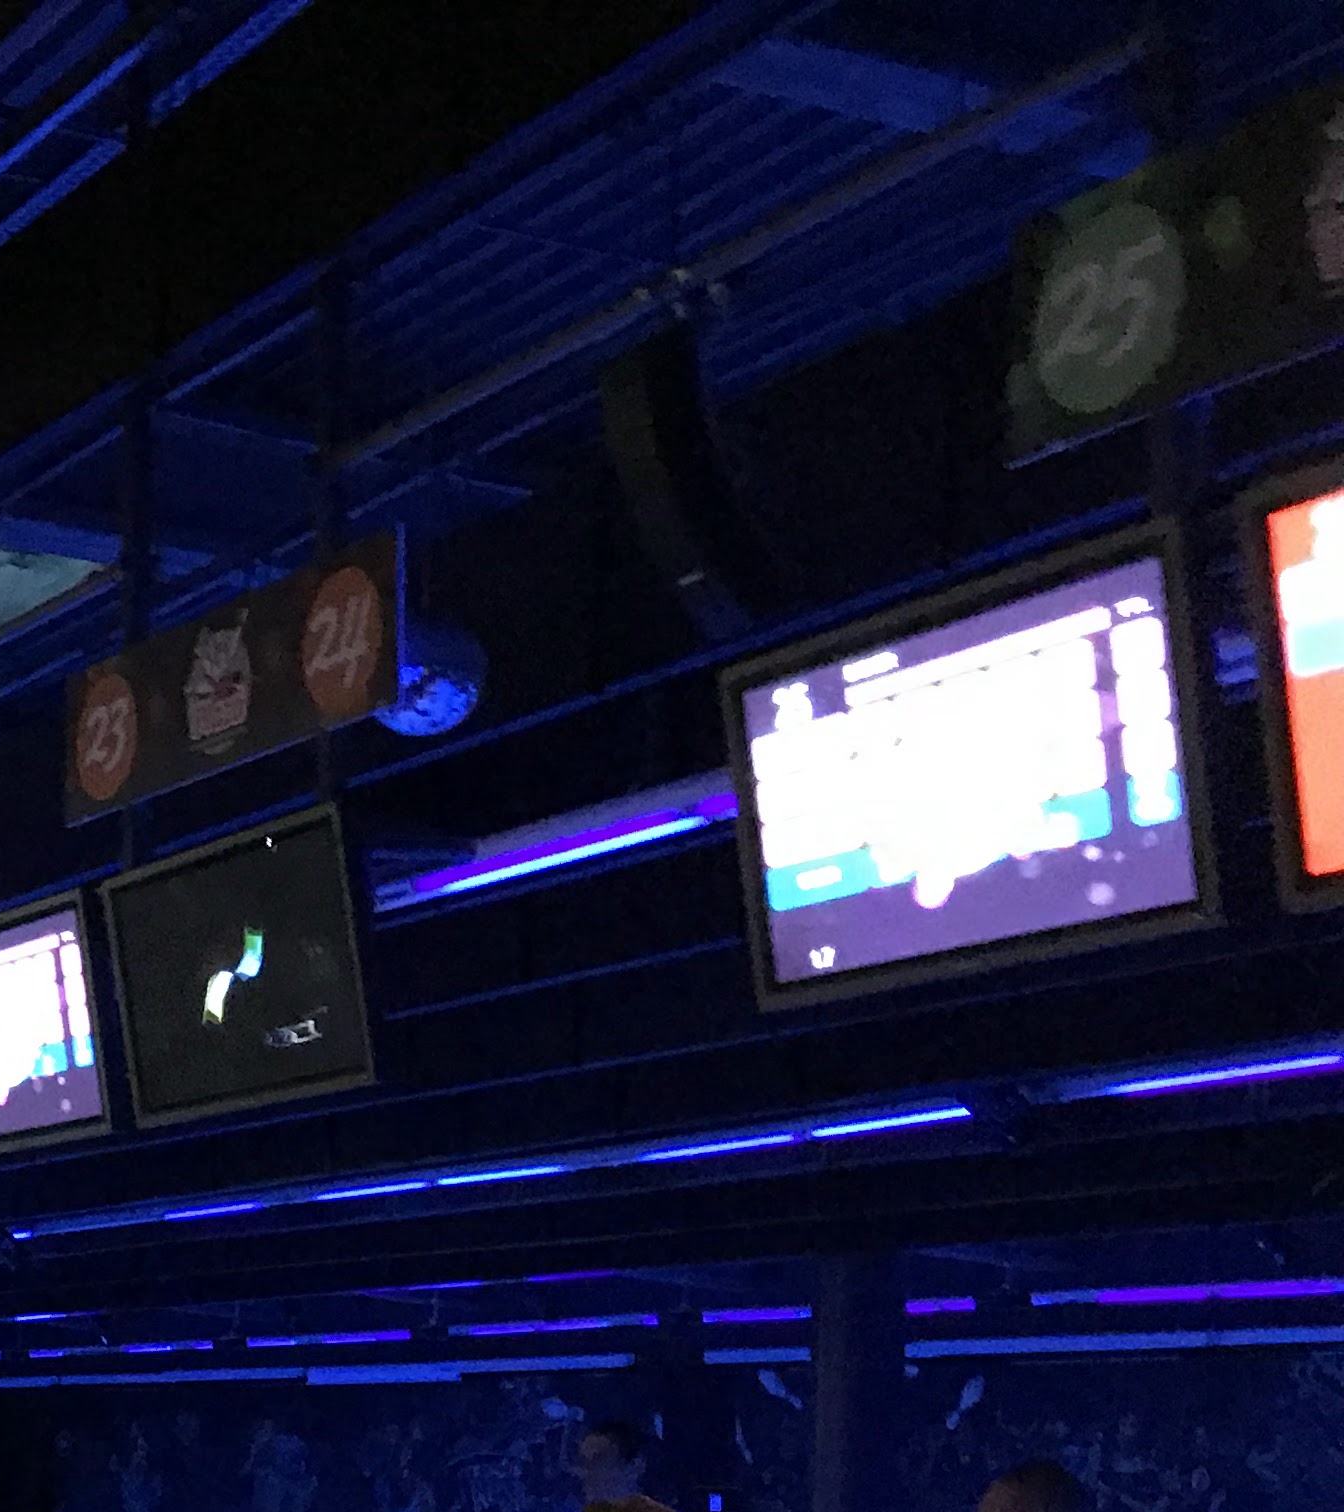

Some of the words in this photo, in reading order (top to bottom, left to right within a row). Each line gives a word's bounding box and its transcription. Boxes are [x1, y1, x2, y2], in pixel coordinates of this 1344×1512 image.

[1037, 233, 1165, 367] 25
[83, 696, 130, 774] 23
[304, 595, 370, 688] 24
